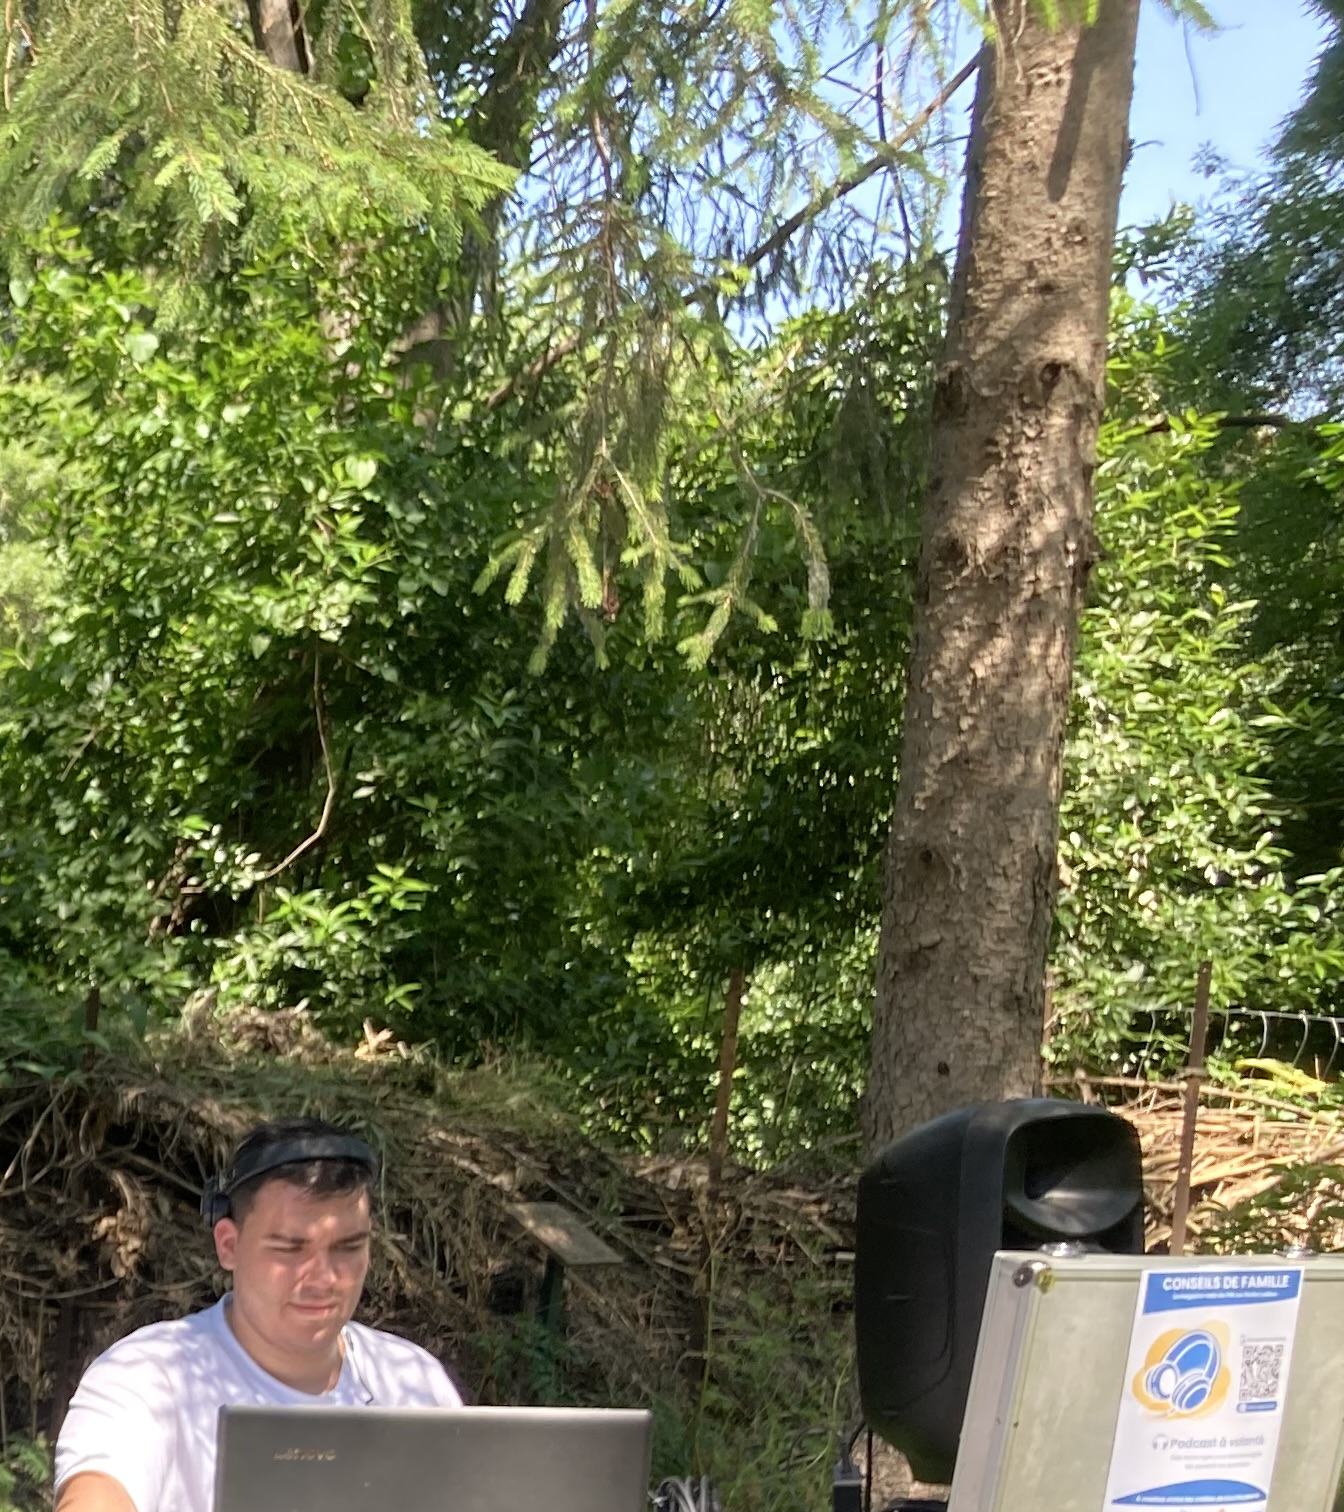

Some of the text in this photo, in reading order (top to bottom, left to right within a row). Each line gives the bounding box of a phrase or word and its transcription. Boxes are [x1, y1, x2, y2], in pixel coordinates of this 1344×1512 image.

[1162, 1274, 1291, 1292] CONSEILS DE FAMILLE
